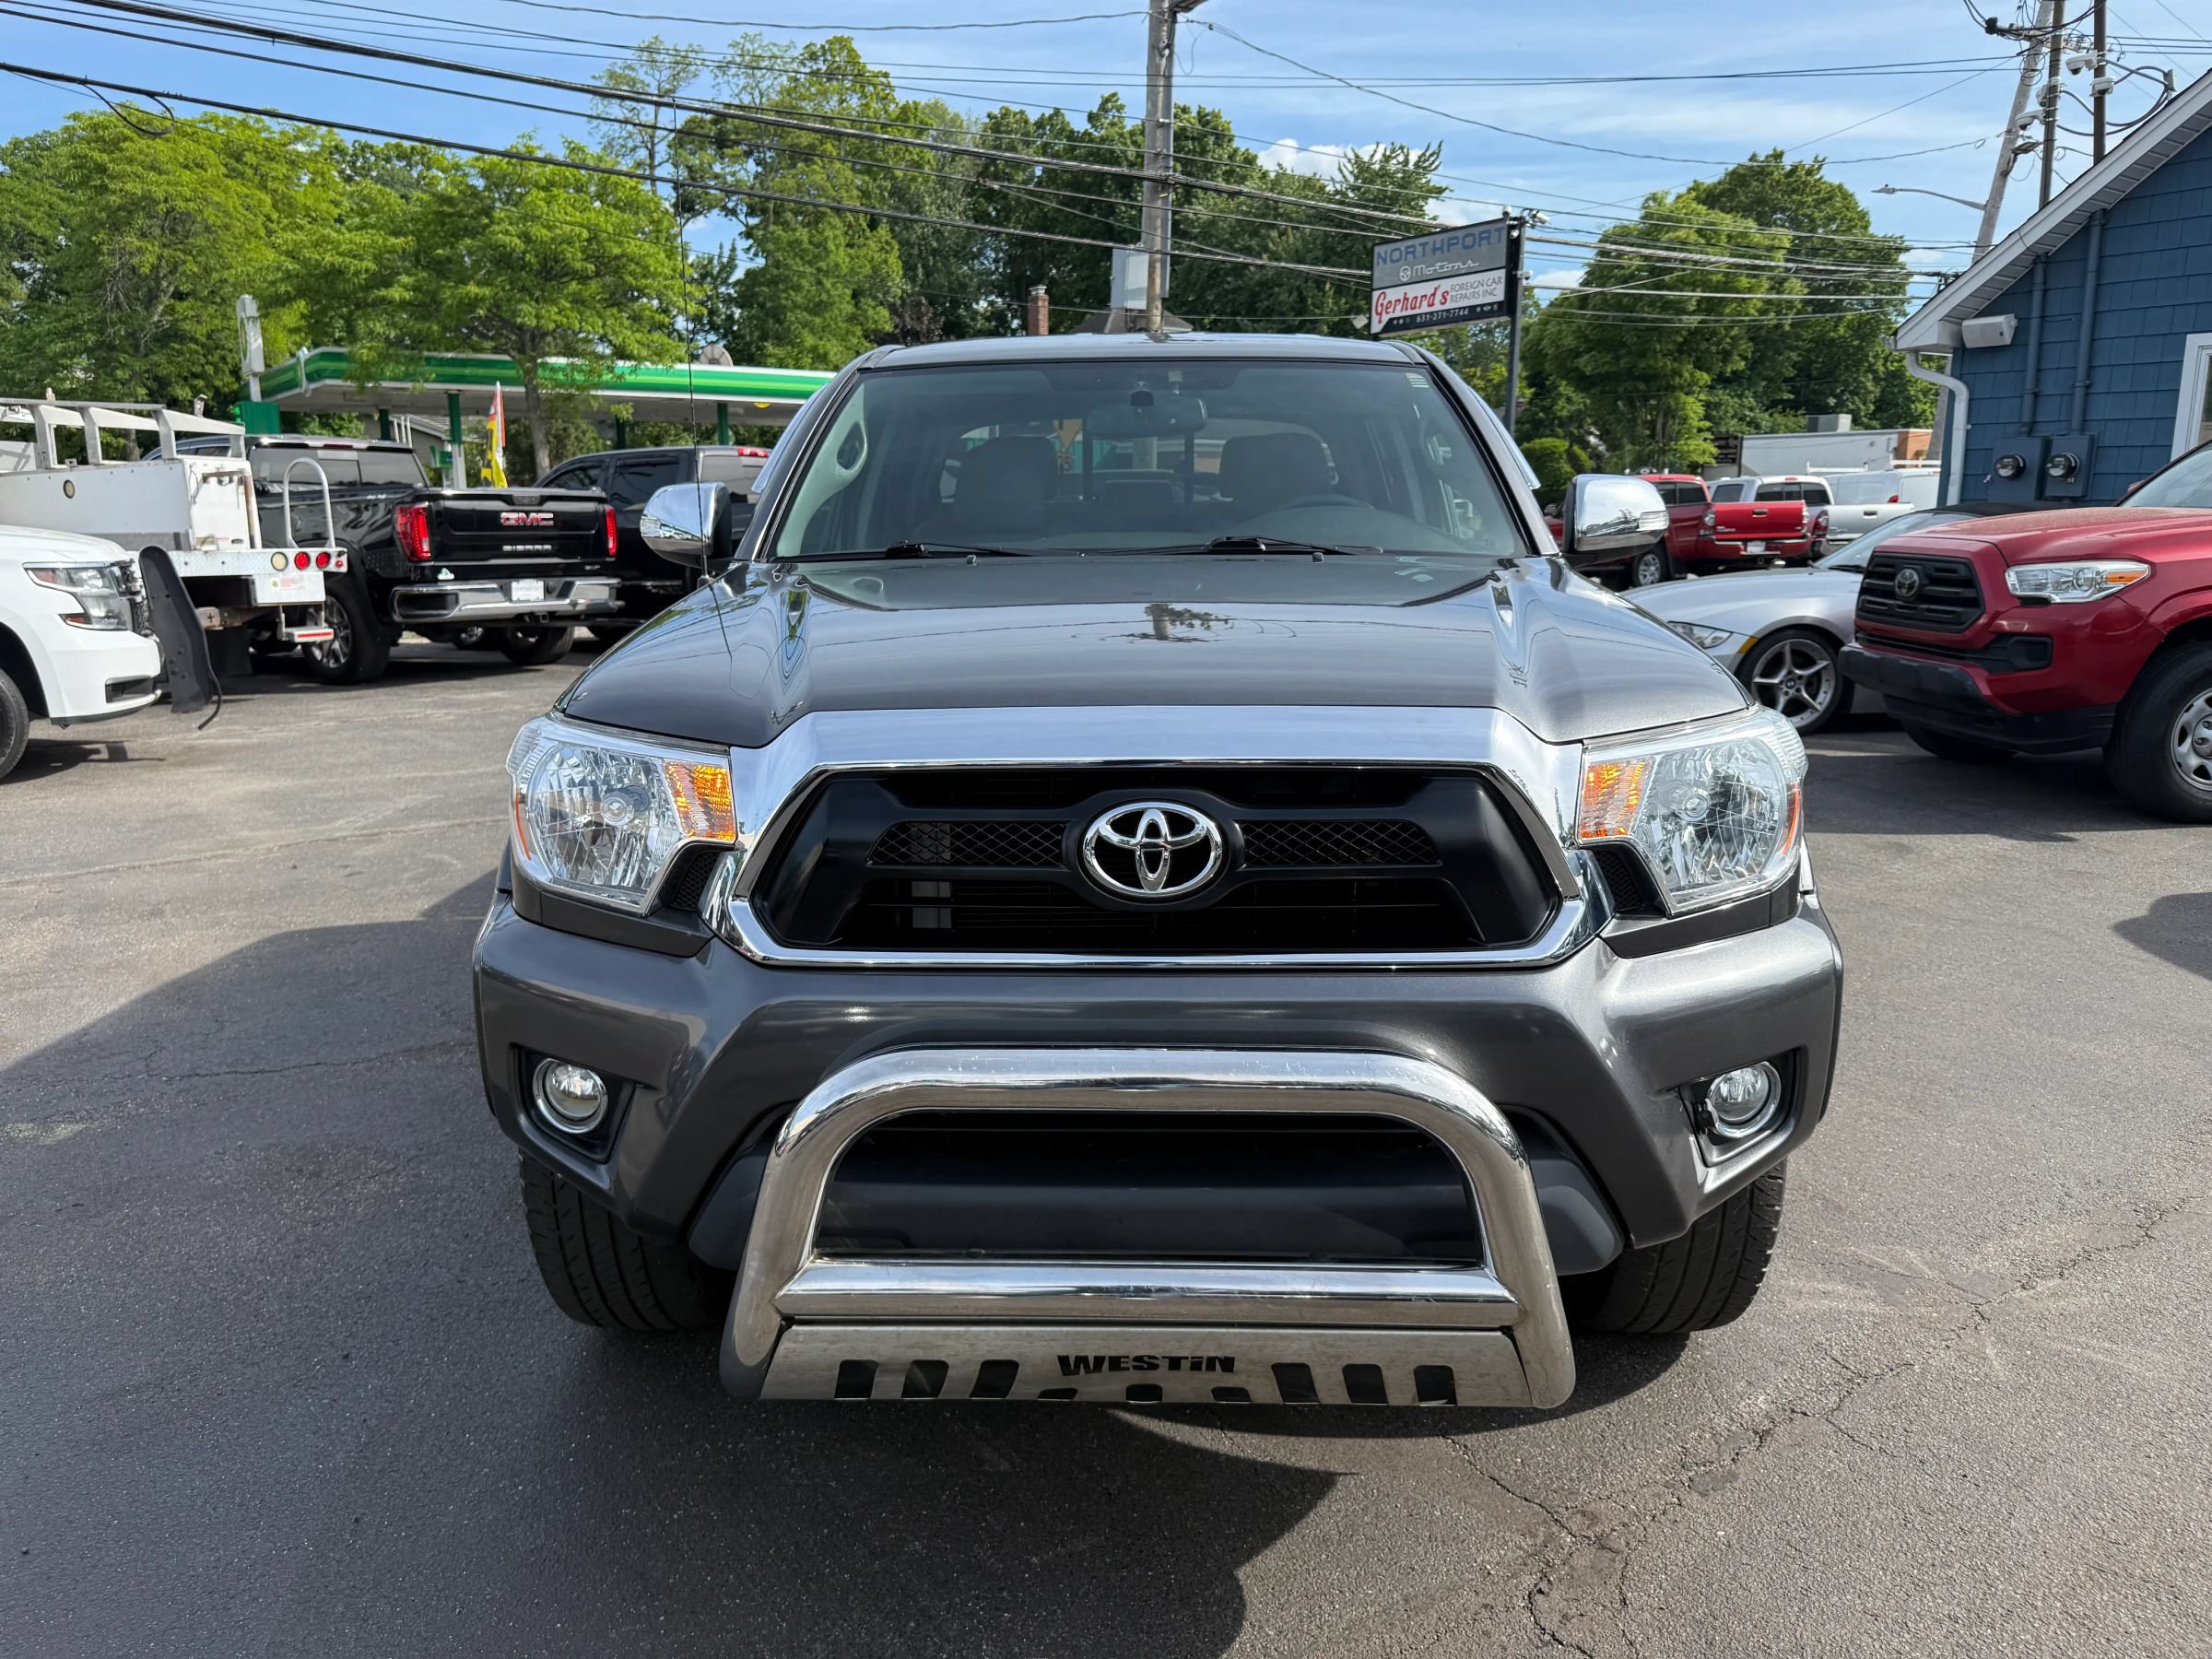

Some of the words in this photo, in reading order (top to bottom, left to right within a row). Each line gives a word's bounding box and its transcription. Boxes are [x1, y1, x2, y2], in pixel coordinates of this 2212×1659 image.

[1376, 227, 1505, 265] NORTHPORT
[1413, 260, 1479, 276] Motors
[1451, 280, 1485, 292] FOREIGN
[1486, 276, 1503, 287] CAR
[1451, 290, 1480, 302] REPAIRS
[1482, 287, 1498, 297] INC
[1375, 285, 1449, 323] Gerhard's
[500, 512, 554, 526] GMC
